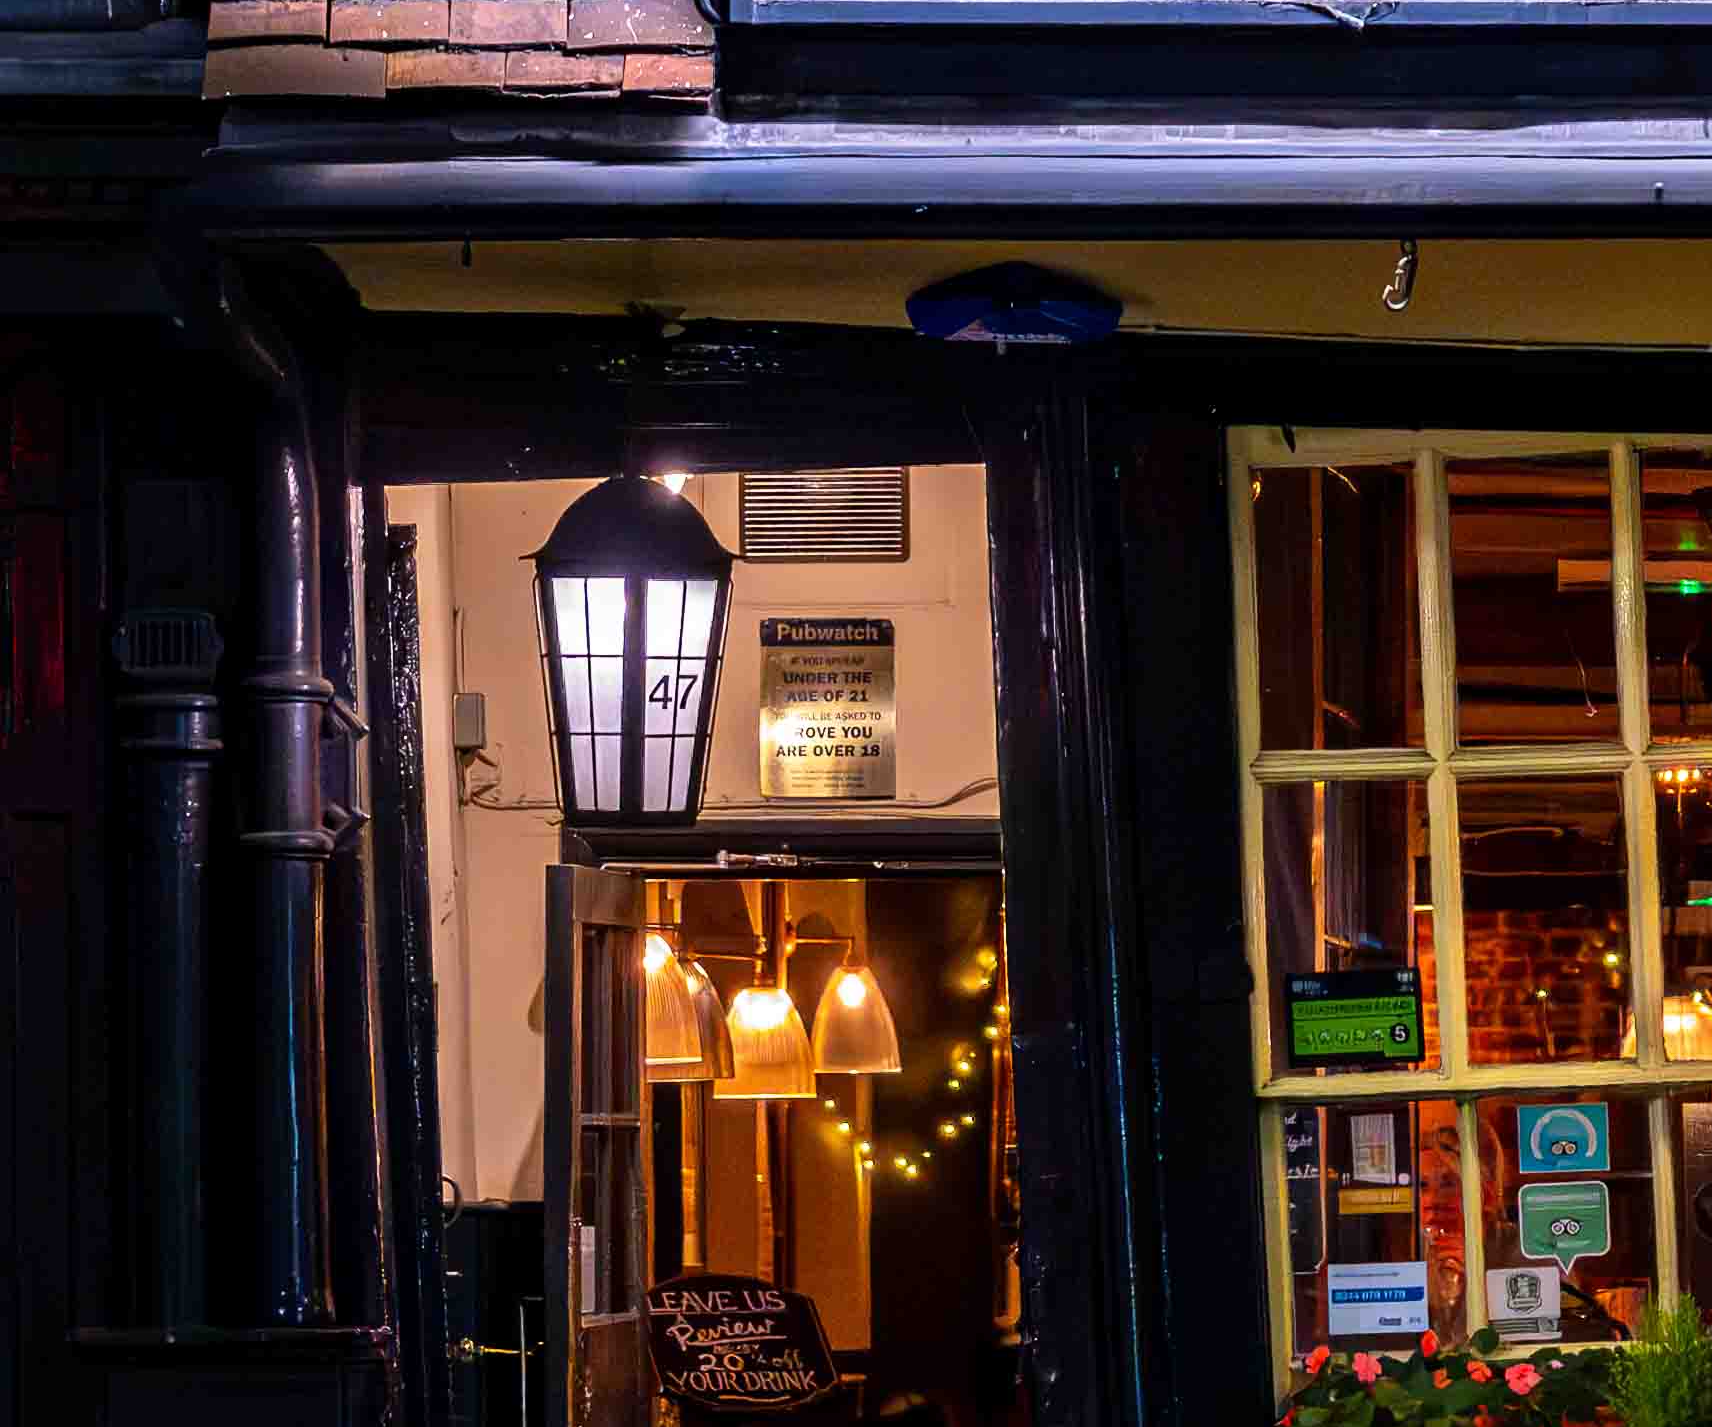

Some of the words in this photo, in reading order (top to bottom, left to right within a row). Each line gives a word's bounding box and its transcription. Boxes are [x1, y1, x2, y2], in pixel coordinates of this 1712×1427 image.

[777, 623, 879, 641] Pubwatch
[784, 672, 838, 685] UNDER
[844, 672, 873, 684] THE
[648, 674, 699, 710] 47
[824, 690, 845, 702] OF
[849, 690, 868, 702] 21
[835, 711, 867, 721] ASKED
[870, 711, 882, 721] TO
[789, 726, 838, 738] ROVE
[842, 726, 873, 739] YOU
[776, 745, 807, 757] ARE
[813, 745, 855, 757] OVER
[861, 744, 881, 757] 18
[1394, 1025, 1407, 1041] 5
[648, 1290, 738, 1313] LEAVE
[744, 1290, 786, 1311] US
[666, 1316, 775, 1351] Review
[666, 1370, 744, 1392] YOUR
[744, 1370, 818, 1392] DRINK
